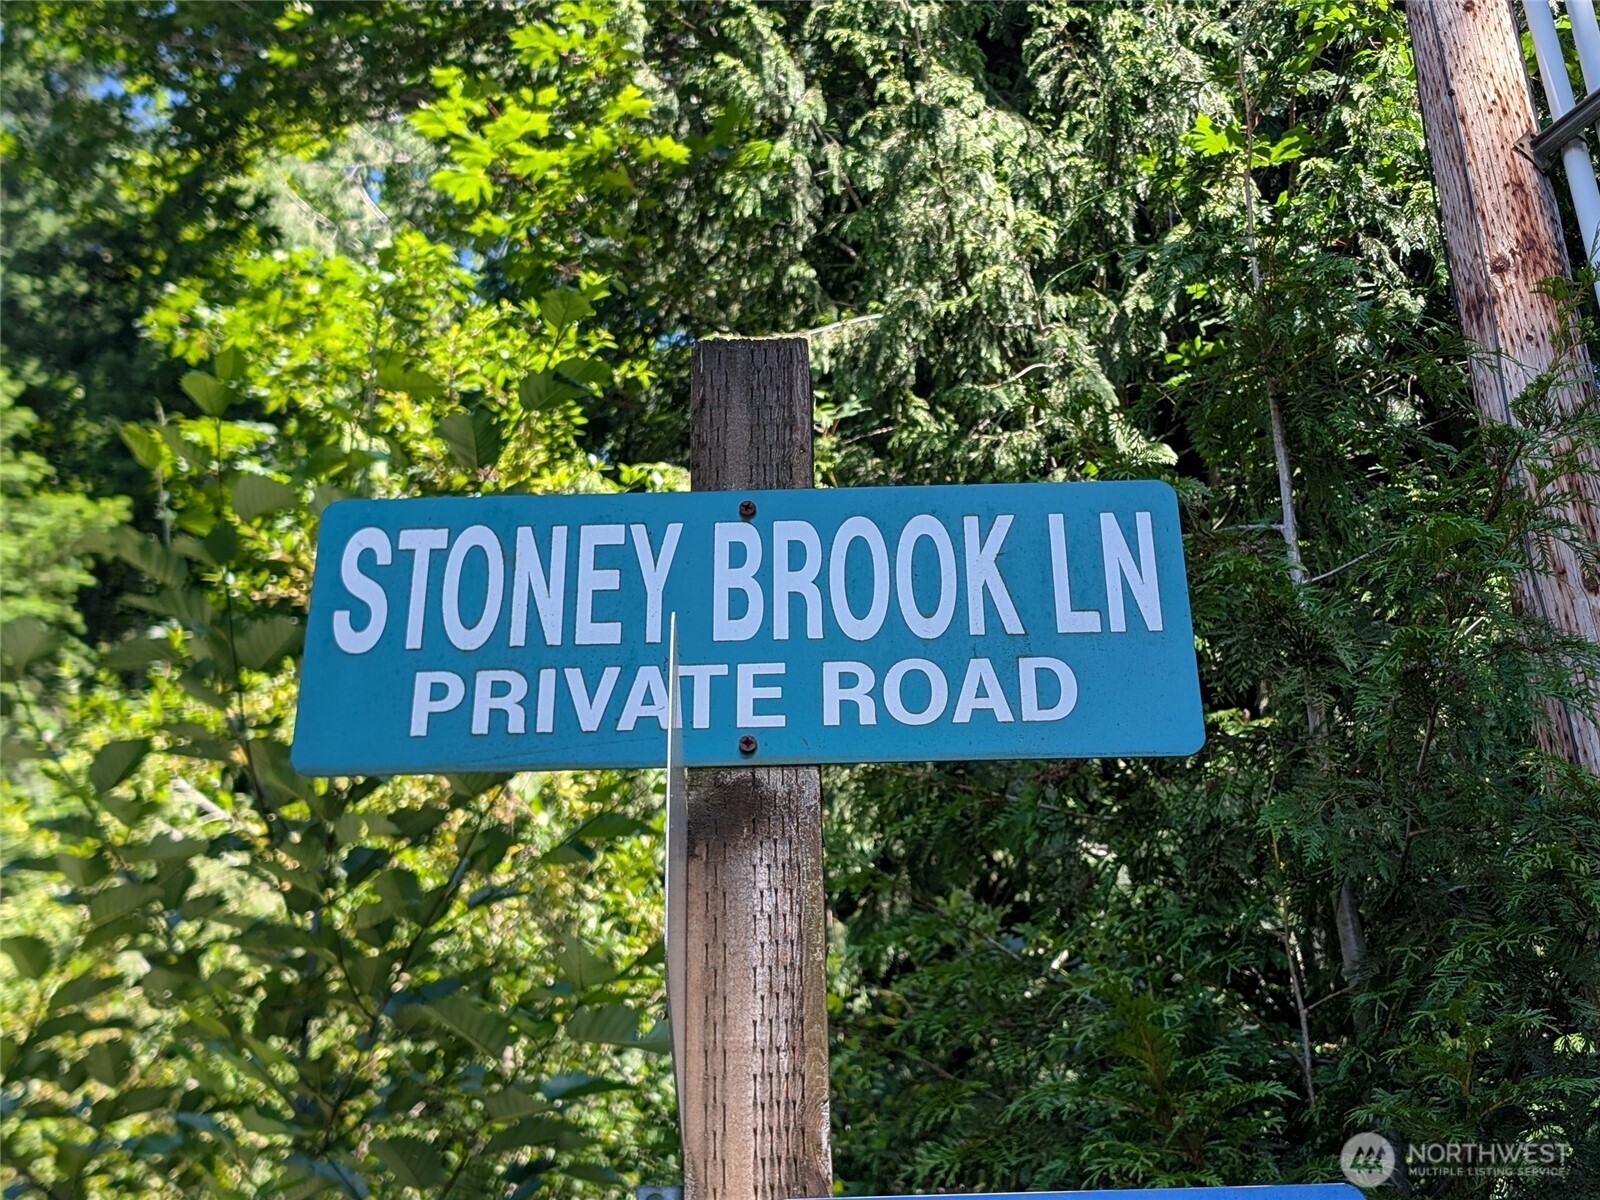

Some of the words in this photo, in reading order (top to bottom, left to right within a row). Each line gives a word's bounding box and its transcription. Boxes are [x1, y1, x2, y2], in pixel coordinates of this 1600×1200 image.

[332, 522, 684, 654] STONEY
[713, 514, 1026, 641] BROOK
[1049, 511, 1163, 633] LN
[409, 663, 786, 737] PRIVATE
[822, 657, 1078, 726] ROAD
